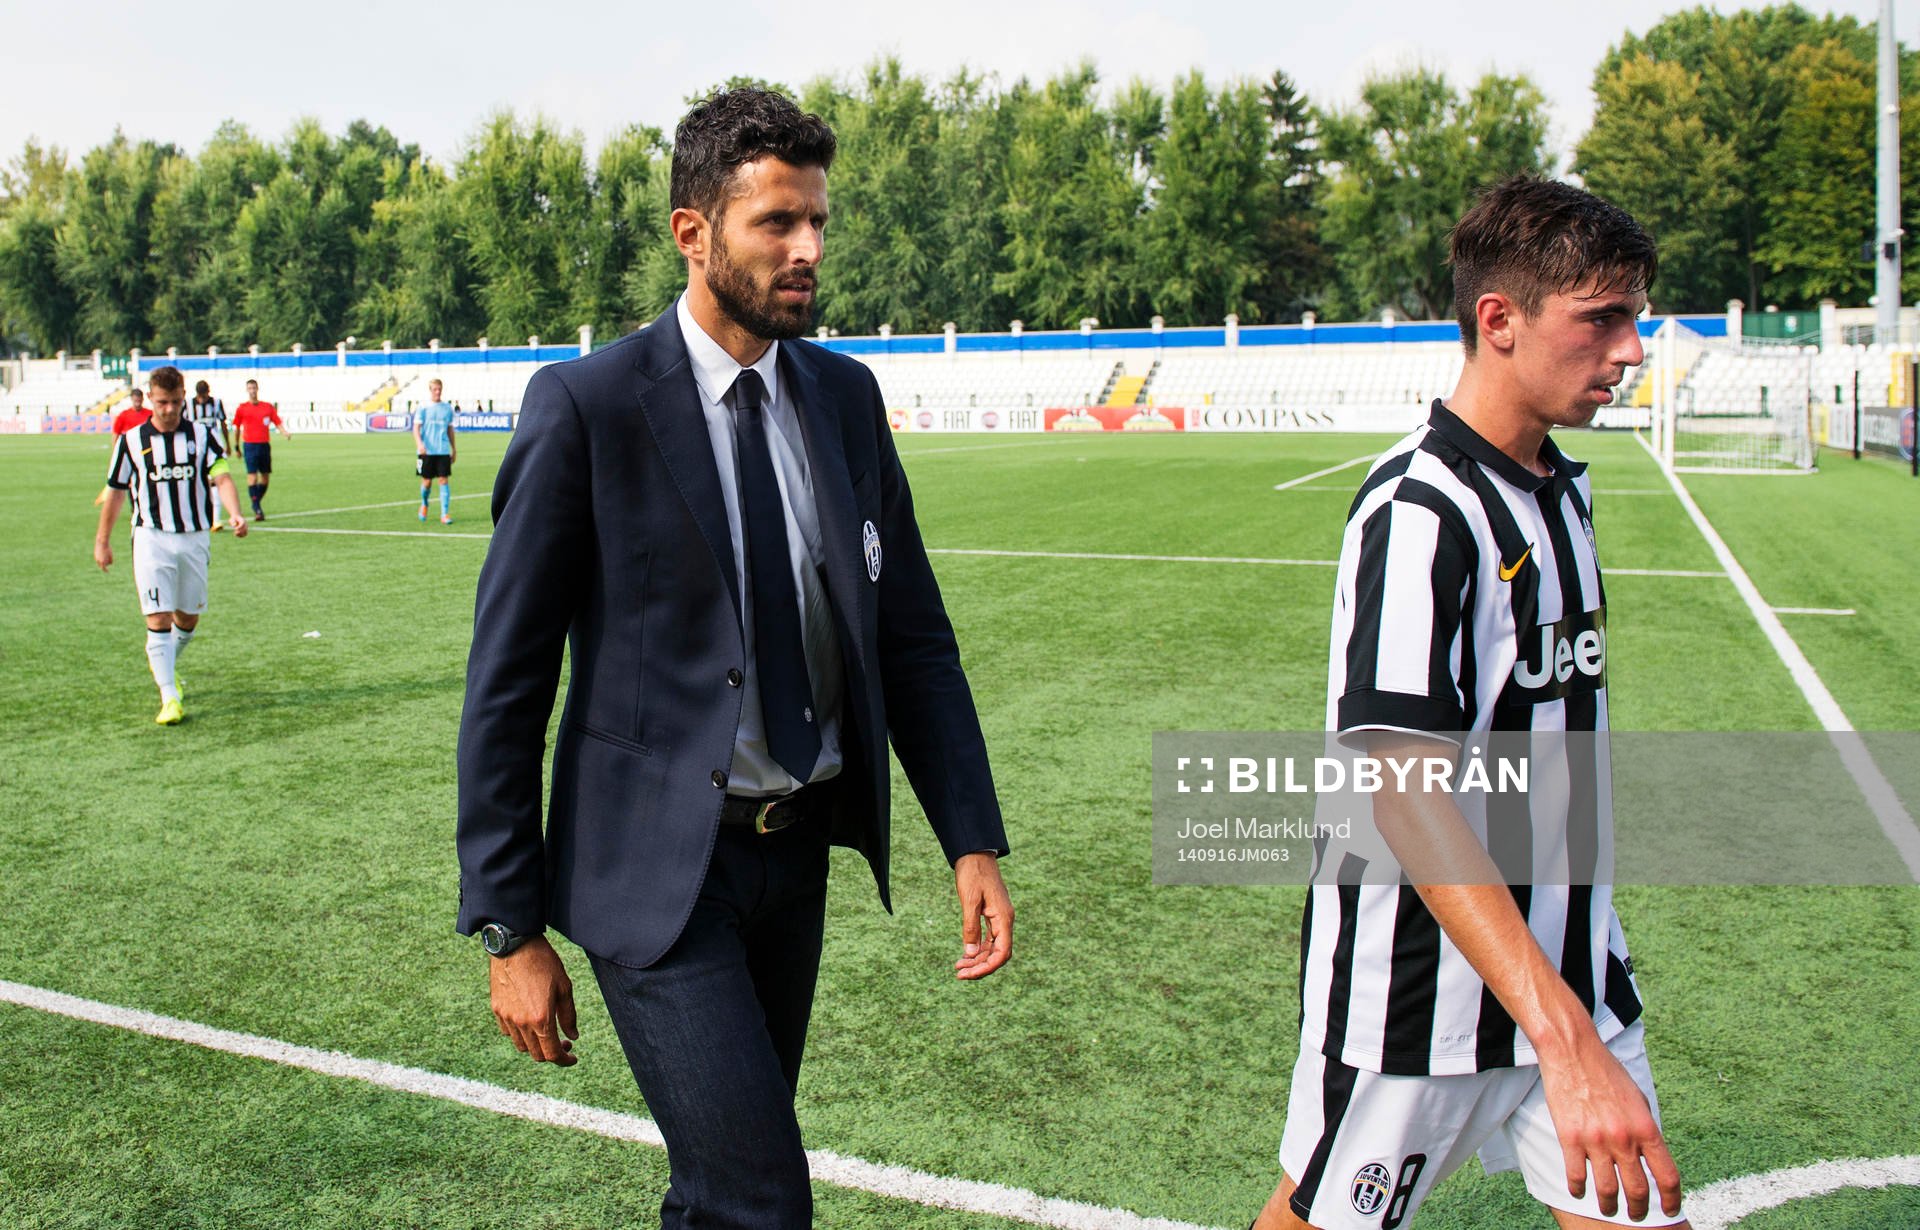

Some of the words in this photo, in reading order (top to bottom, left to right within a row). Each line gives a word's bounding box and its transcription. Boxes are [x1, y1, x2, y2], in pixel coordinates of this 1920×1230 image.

[453, 416, 472, 428] UTH
[473, 416, 509, 428] LEAGUE
[943, 410, 971, 429] FIAT
[1009, 410, 1038, 429] FIAT
[1204, 408, 1334, 428] COMPASS
[149, 464, 194, 481] Jeep
[1359, 1173, 1389, 1189] JUVENTUS
[1381, 1153, 1427, 1230] 8
